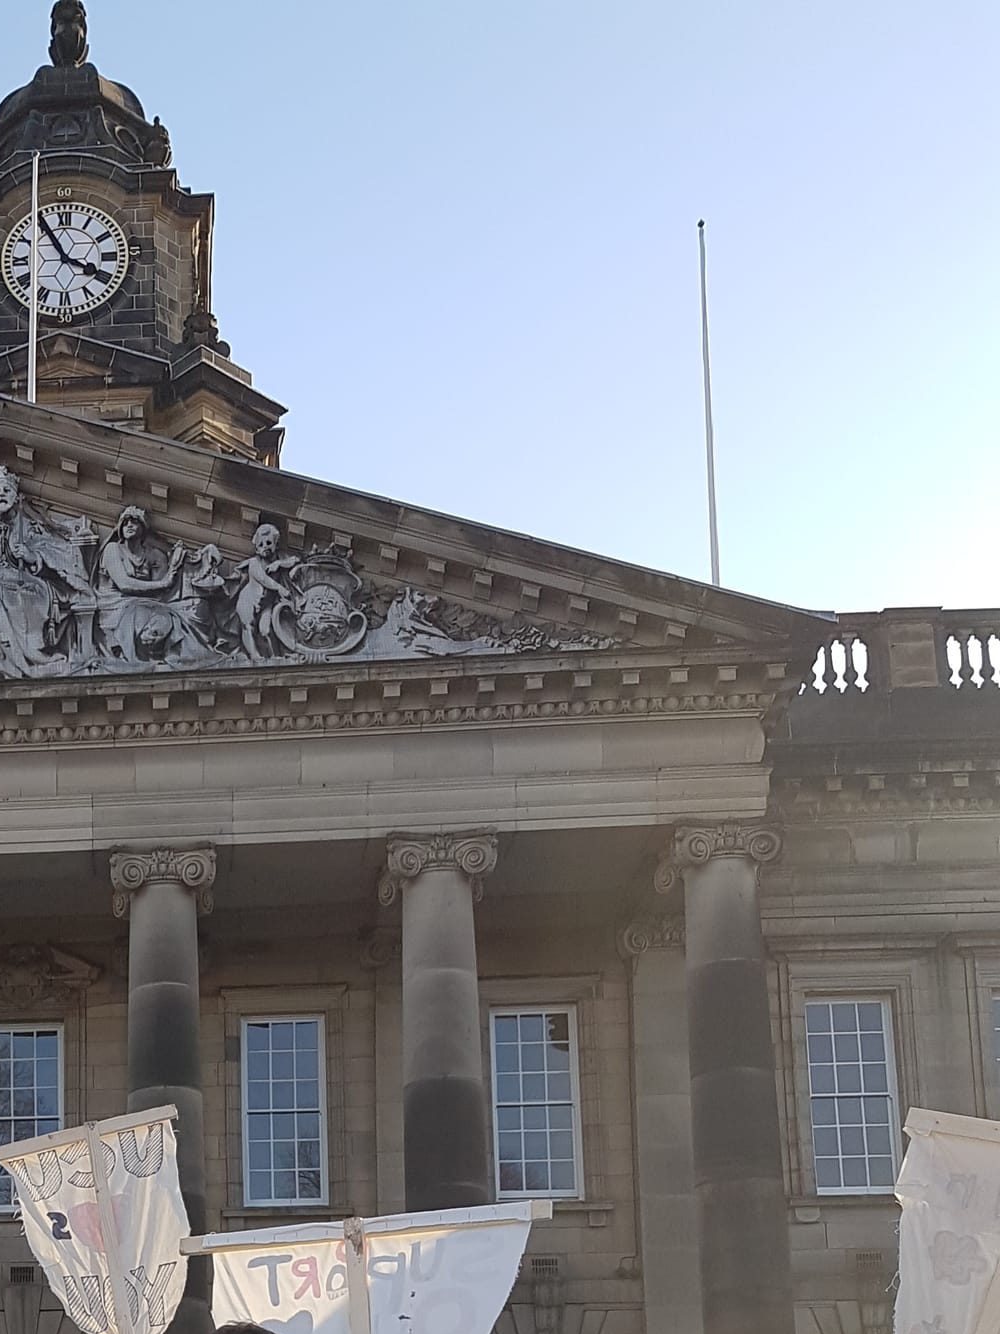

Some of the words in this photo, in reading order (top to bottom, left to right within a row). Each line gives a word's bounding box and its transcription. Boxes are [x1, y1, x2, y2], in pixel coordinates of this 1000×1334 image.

[57, 187, 72, 197] 60
[58, 212, 71, 226] XII
[130, 246, 140, 255] 15
